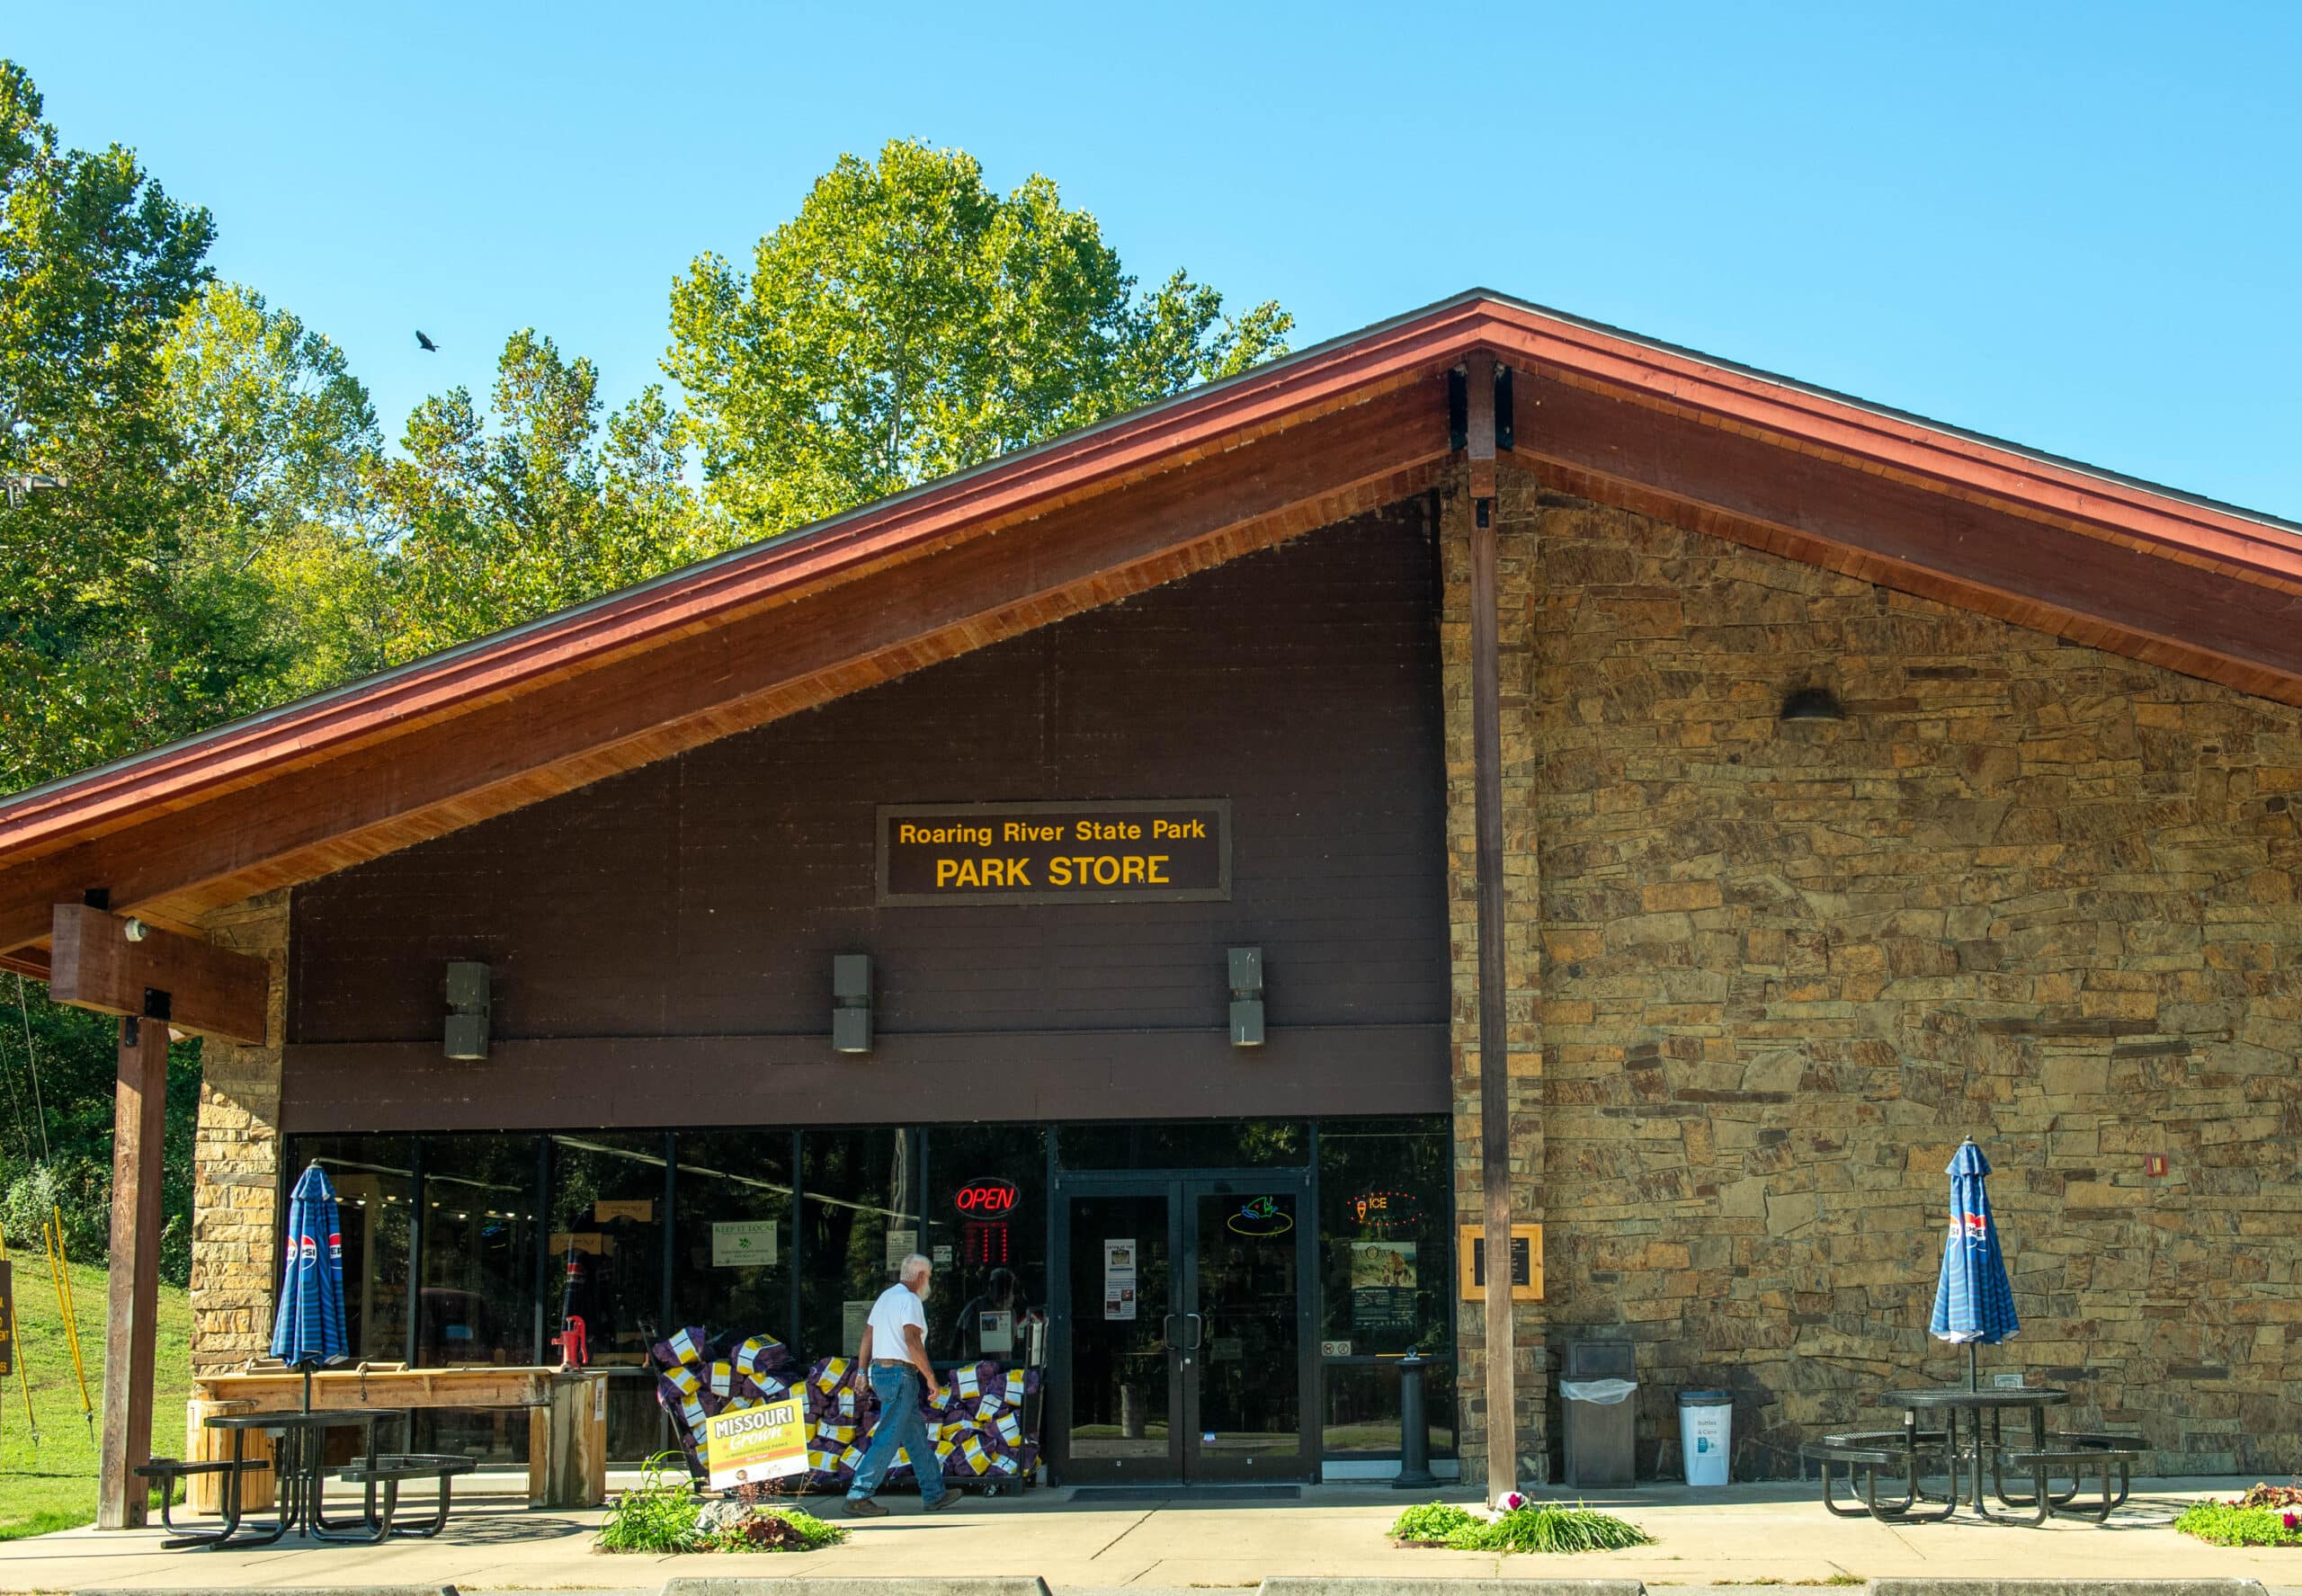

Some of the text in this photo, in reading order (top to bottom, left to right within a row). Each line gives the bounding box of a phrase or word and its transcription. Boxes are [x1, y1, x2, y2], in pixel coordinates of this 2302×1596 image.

[899, 819, 1206, 847] Roaring River State Park
[936, 855, 1170, 888] PARK STORE
[956, 1187, 1015, 1209] OPEN
[1369, 1197, 1387, 1209] ICE
[714, 1404, 795, 1439] MISSOURI
[730, 1425, 783, 1451] Grown
